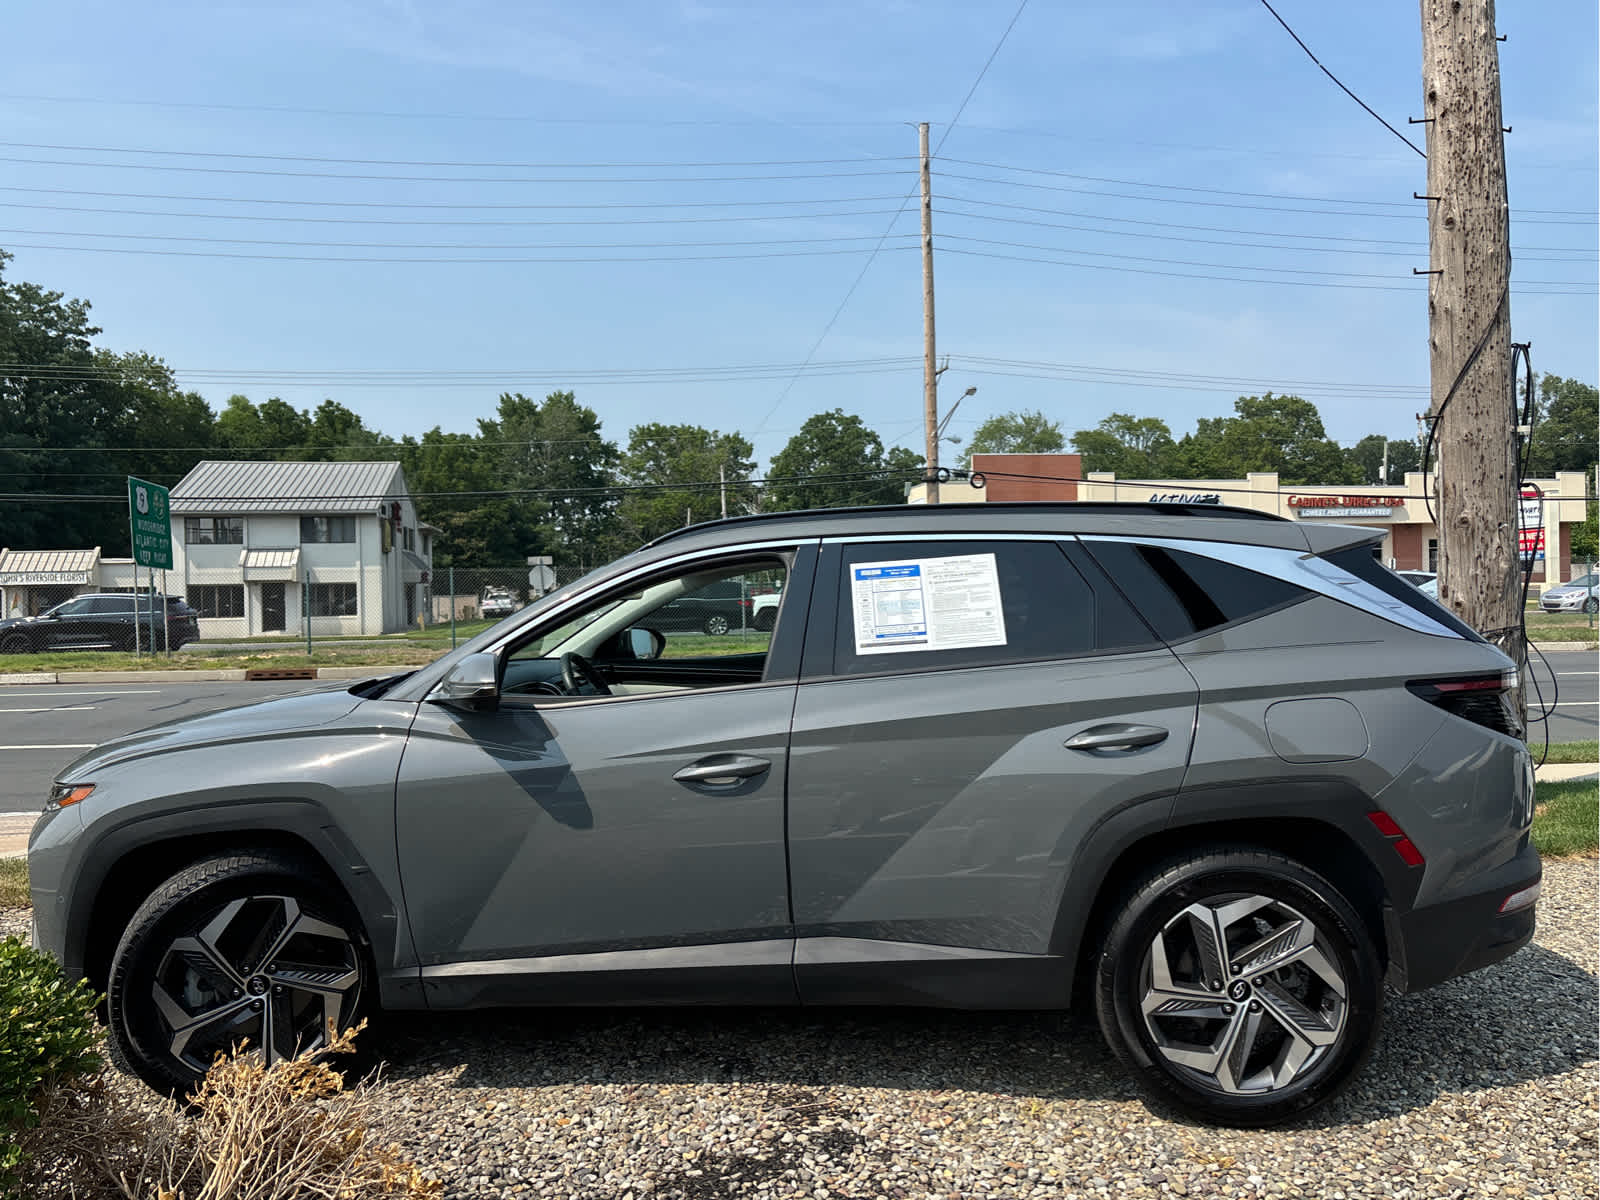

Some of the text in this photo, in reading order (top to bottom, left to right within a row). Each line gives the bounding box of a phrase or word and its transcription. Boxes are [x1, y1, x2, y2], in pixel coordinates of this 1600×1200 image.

[1288, 495, 1405, 507] CABINETS DIRECT USA
[26, 573, 58, 583] RIVERSIDE
[60, 573, 86, 582] FLORIST
